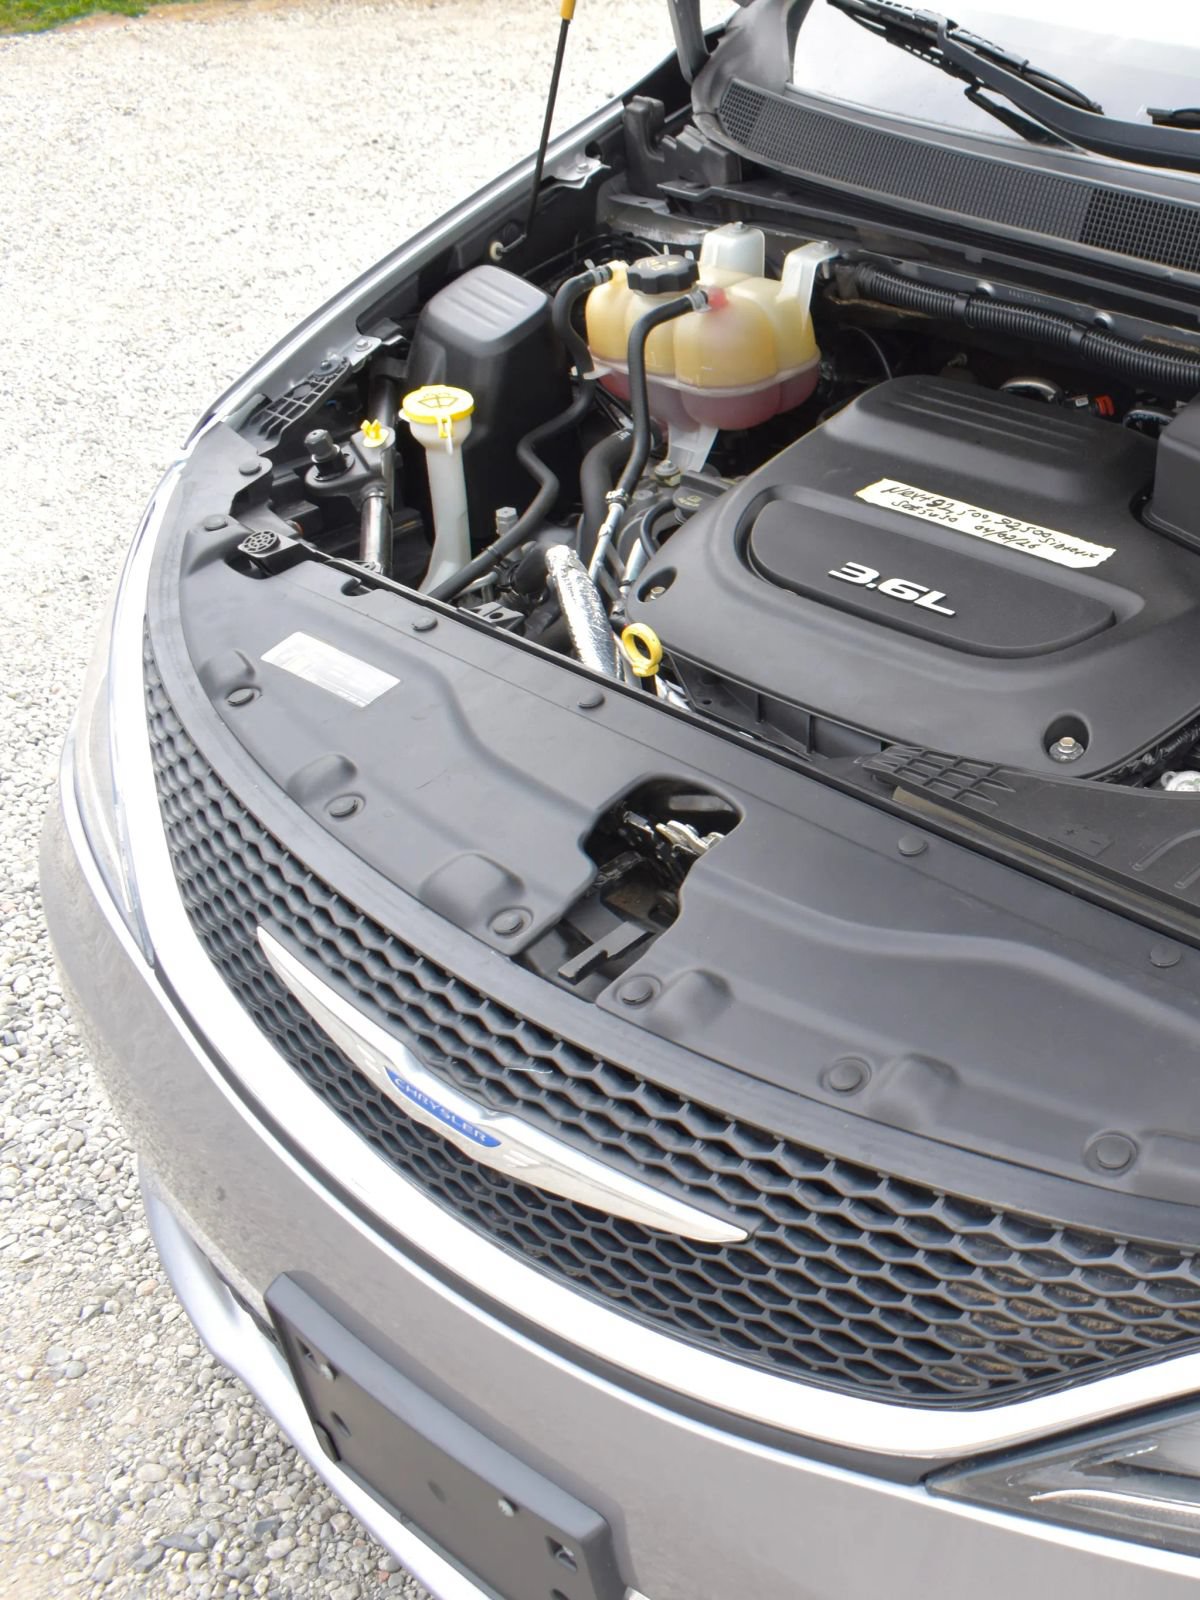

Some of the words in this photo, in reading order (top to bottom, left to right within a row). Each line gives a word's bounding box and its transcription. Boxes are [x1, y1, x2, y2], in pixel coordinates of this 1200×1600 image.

[880, 486, 934, 501] Next
[827, 561, 956, 616] 3.6L
[394, 1077, 487, 1142] CHRYSLER
